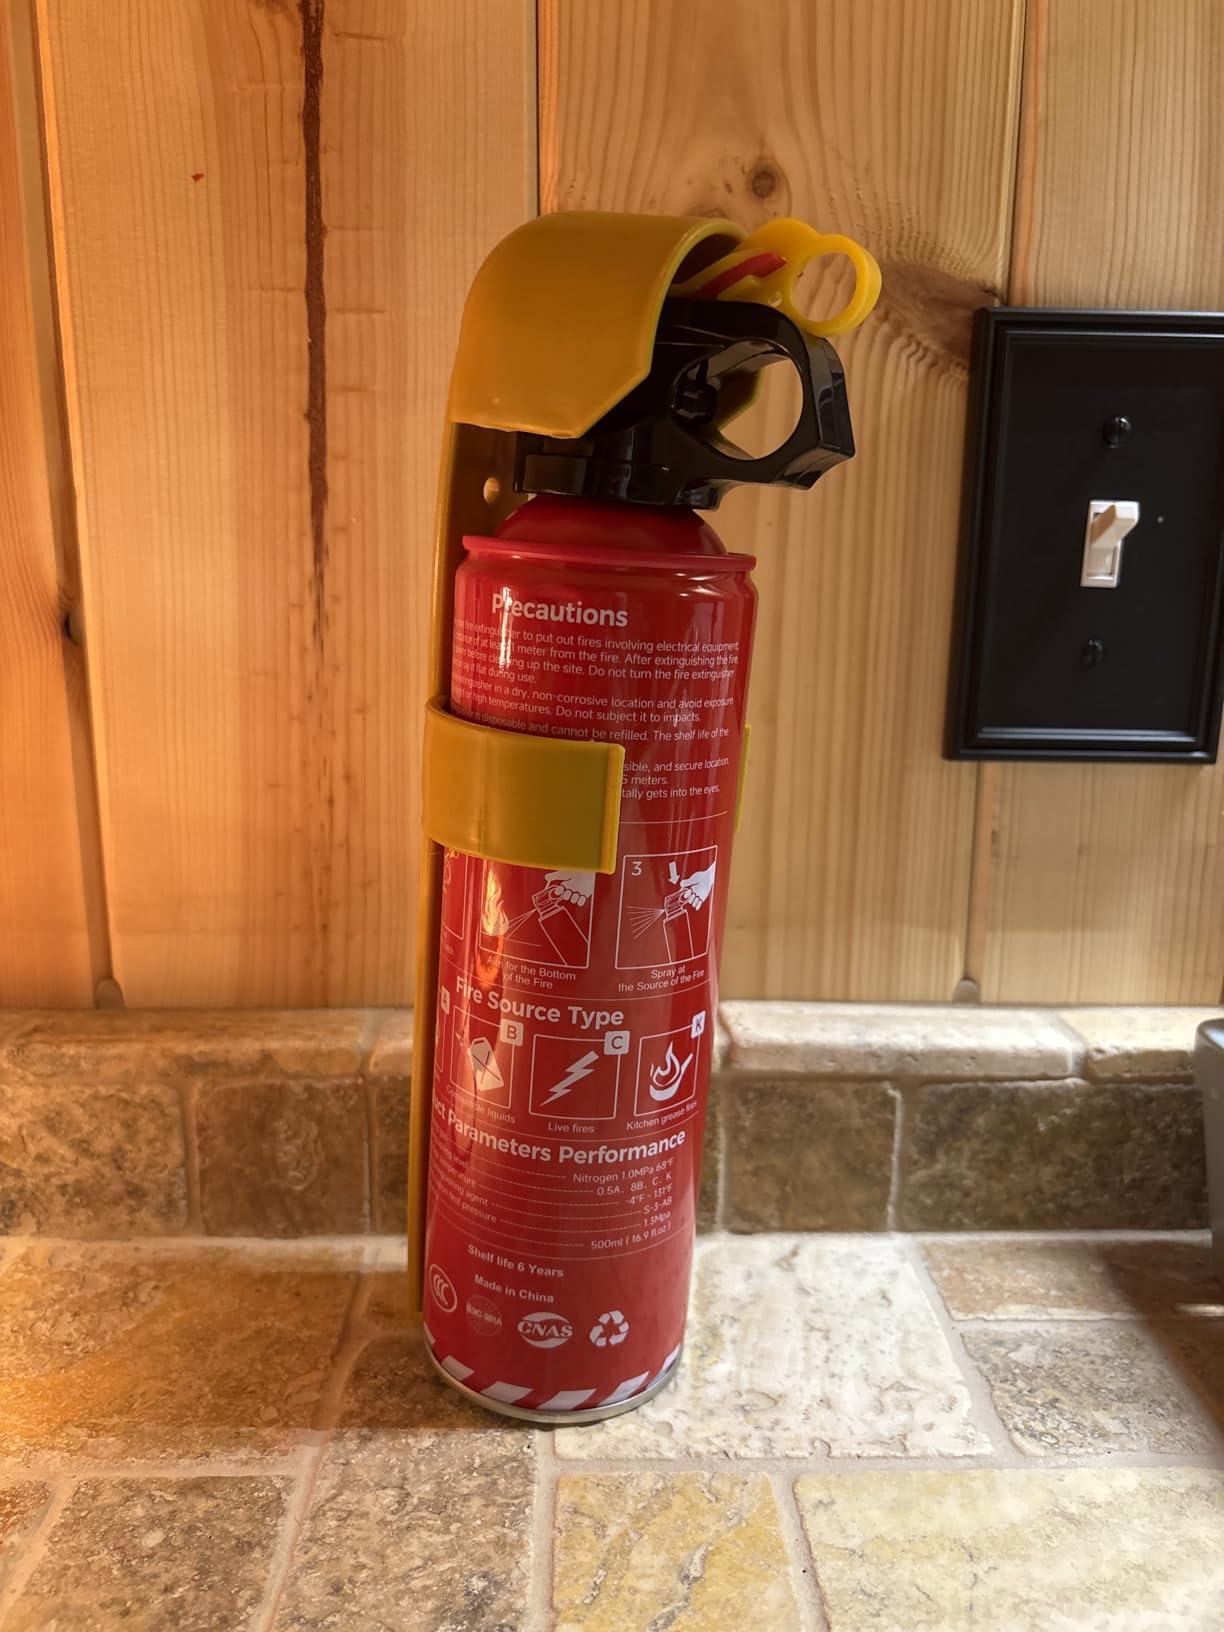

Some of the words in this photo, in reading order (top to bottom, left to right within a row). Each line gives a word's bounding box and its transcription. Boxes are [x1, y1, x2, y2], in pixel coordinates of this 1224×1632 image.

[523, 630, 533, 640] to
[535, 633, 554, 643] put
[556, 635, 574, 645] out
[577, 636, 602, 648] fires
[604, 640, 654, 653] involving
[656, 641, 700, 653] electrical
[517, 644, 547, 656] meter
[550, 648, 576, 659] from
[579, 650, 597, 661] the
[600, 652, 620, 663] fire.
[624, 653, 652, 665] After
[654, 655, 715, 668] extinguishing
[716, 655, 728, 665] the
[517, 673, 537, 684] use.
[526, 660, 540, 671] up
[543, 660, 560, 672] the
[563, 663, 585, 675] site.
[588, 664, 605, 676] Do
[608, 668, 626, 678] not
[630, 670, 652, 679] turn
[655, 669, 671, 679] the
[674, 669, 690, 680] fire
[691, 669, 735, 682] extinguisher
[494, 682, 502, 693] in
[504, 687, 510, 695] a
[532, 691, 608, 706] non-corrosive
[611, 696, 654, 708] location
[657, 698, 676, 709] and
[678, 697, 703, 709] avoid
[703, 697, 734, 710] exposure
[488, 695, 553, 715] temperatures.
[556, 705, 572, 717] Do
[574, 709, 594, 719] not
[596, 711, 636, 723] subject
[640, 711, 647, 722] it
[650, 712, 660, 722] to
[528, 722, 548, 733] and
[551, 724, 588, 738] cannot
[592, 727, 606, 738] be
[609, 729, 649, 741] refilled.
[653, 730, 672, 741] The
[673, 729, 696, 741] shelf
[697, 728, 709, 740] life
[710, 727, 718, 738] of
[623, 761, 651, 773] sible,
[653, 761, 672, 772] and
[674, 760, 703, 771] secure
[704, 757, 729, 769] location
[631, 775, 668, 785] meters.
[621, 787, 644, 800] tally
[645, 789, 668, 801] gets
[670, 787, 688, 797] into
[689, 786, 703, 796] the
[703, 784, 720, 795] eyes.
[631, 861, 642, 877] 3
[505, 961, 518, 971] for
[520, 964, 536, 975] the
[539, 967, 577, 981] Bottom
[651, 968, 677, 979] Spray
[677, 965, 686, 975] at
[504, 972, 514, 981] of
[515, 973, 531, 985] the
[533, 977, 553, 989] Fire
[618, 983, 634, 992] the
[636, 978, 669, 991] Source
[670, 976, 679, 985] of
[680, 973, 692, 983] the
[692, 970, 705, 980] Fire
[456, 975, 483, 1004] Fire
[487, 991, 561, 1023] Source
[568, 1006, 625, 1030] Type
[507, 1025, 517, 1040] B
[611, 1035, 623, 1050] C
[487, 1107, 516, 1124] liquids
[626, 1117, 660, 1131] Kitchen
[660, 1108, 685, 1125] grease
[448, 1108, 552, 1162] Parameters
[559, 1130, 686, 1164] Performance
[548, 1121, 570, 1132] Live
[572, 1123, 595, 1133] fires
[573, 1173, 618, 1184] Nitrogen
[462, 1201, 497, 1224] pressure
[591, 1239, 623, 1250] 500ml
[467, 1243, 494, 1264] Shelf
[496, 1255, 515, 1270] life
[517, 1262, 525, 1272] 6
[528, 1264, 565, 1278] Years
[474, 1273, 501, 1293] Made
[505, 1285, 516, 1297] in
[519, 1289, 555, 1304] China
[517, 1320, 574, 1338] CNAS
